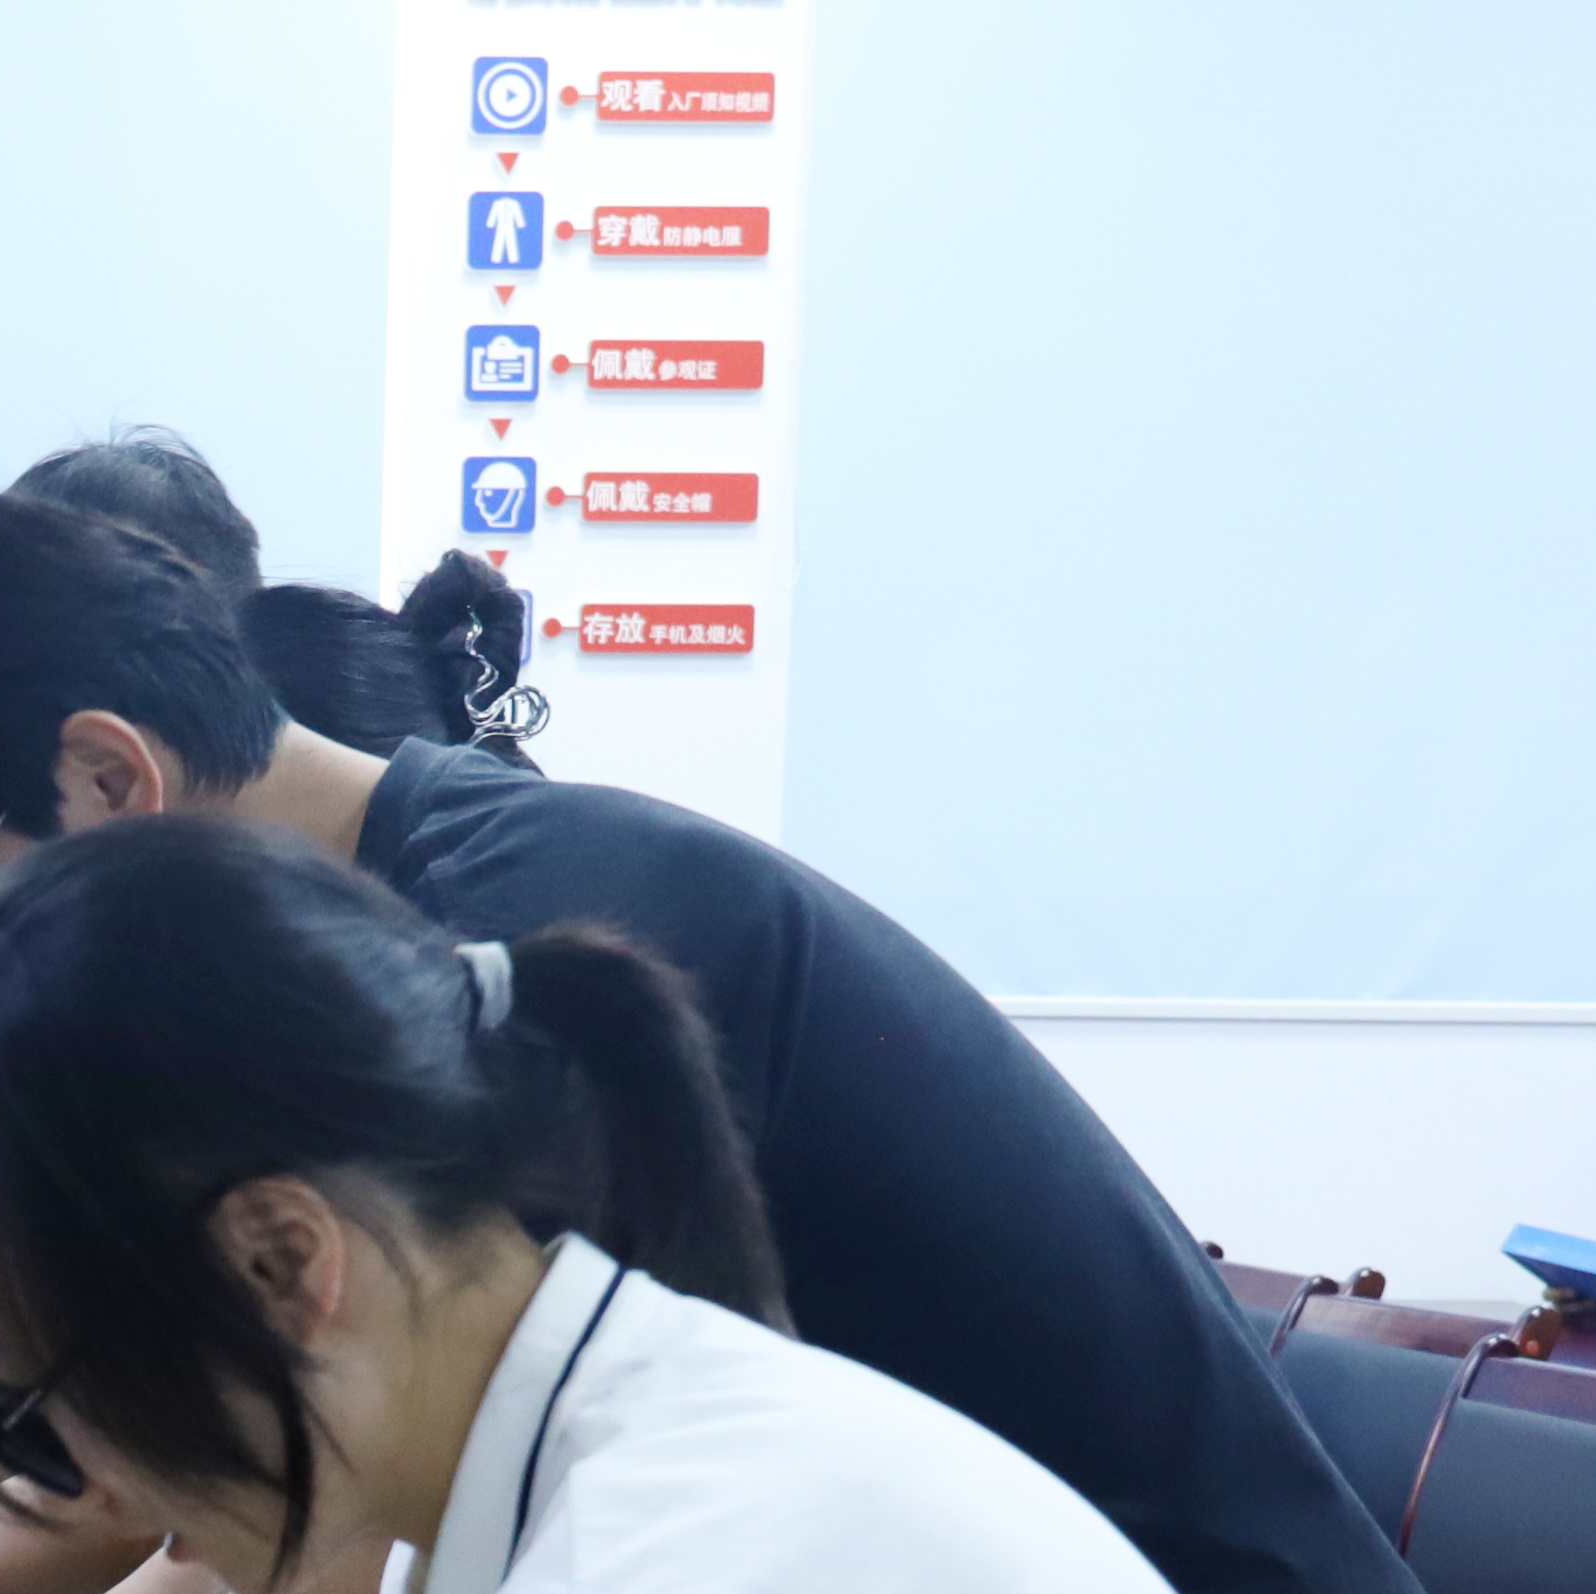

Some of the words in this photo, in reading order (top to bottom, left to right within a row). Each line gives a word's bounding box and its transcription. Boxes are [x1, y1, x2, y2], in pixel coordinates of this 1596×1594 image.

[601, 79, 665, 113] 观看
[597, 214, 662, 248] 穿戴
[663, 225, 743, 247] 防静电服
[592, 347, 657, 381] 佩戴
[659, 359, 718, 381] 参观证
[586, 480, 651, 513] 佩戴
[653, 492, 713, 513] 安全帽
[582, 612, 647, 645] 存放
[649, 624, 747, 645] 手机及烟火
